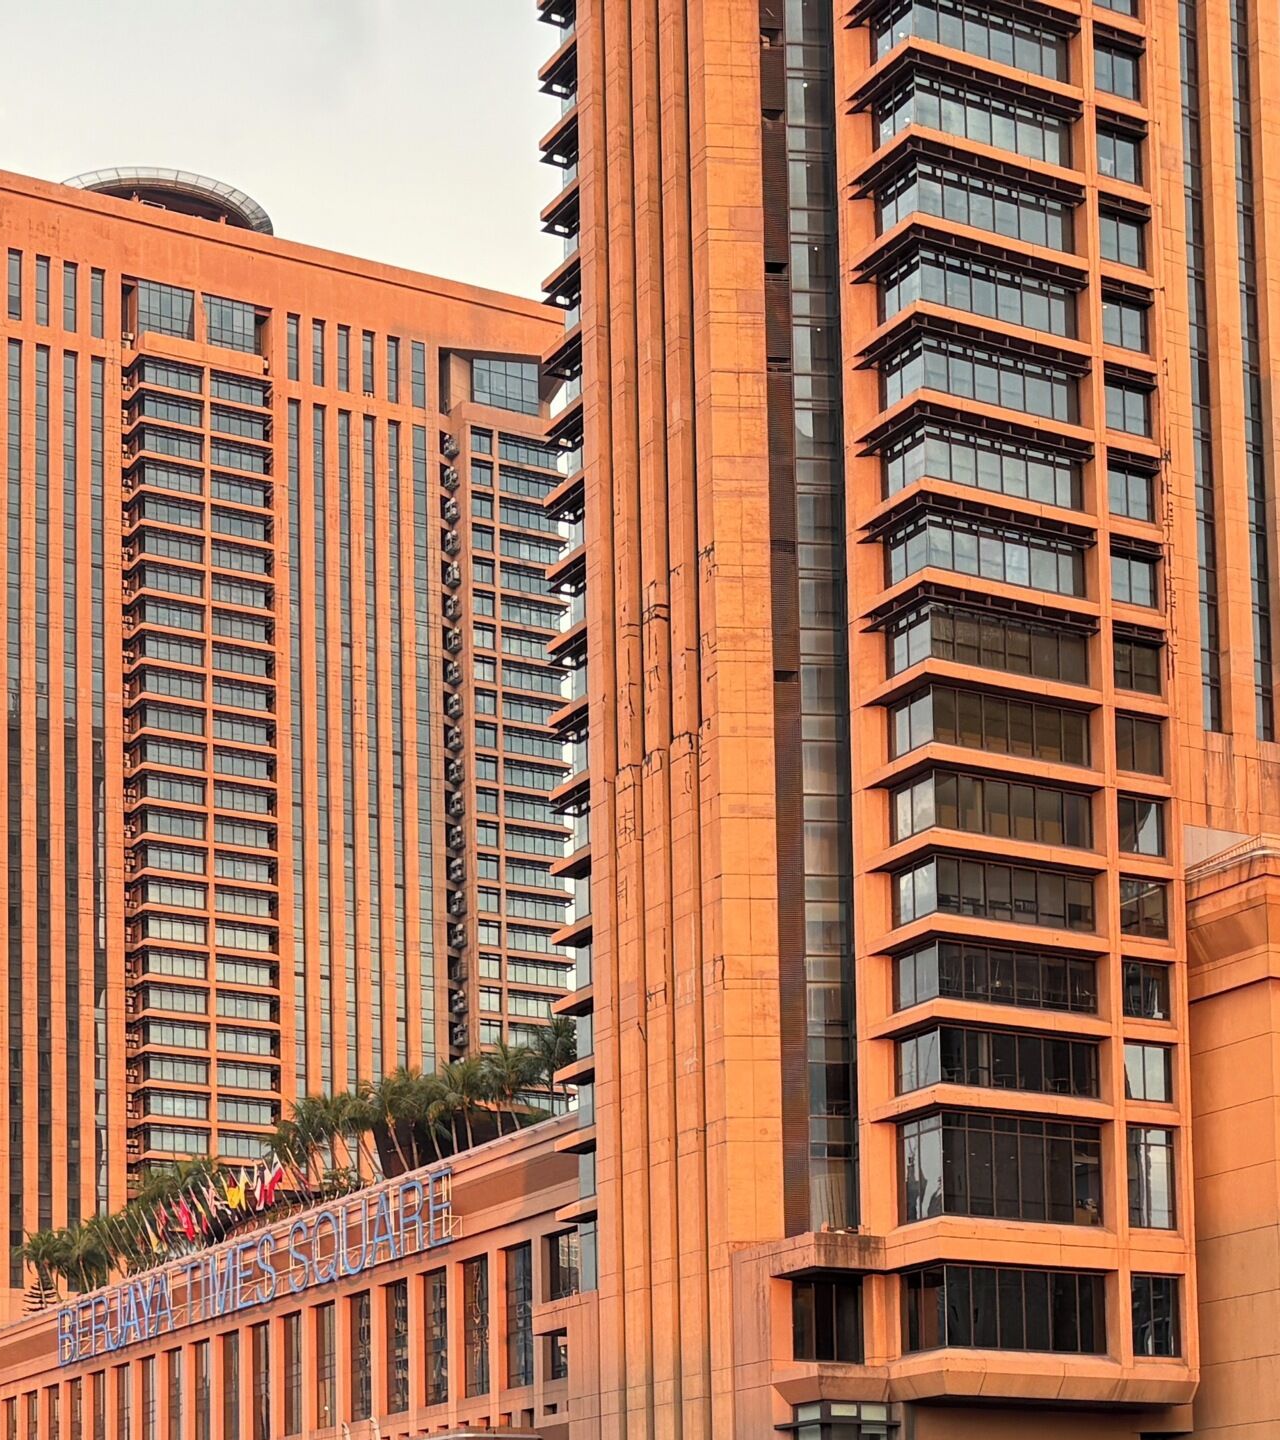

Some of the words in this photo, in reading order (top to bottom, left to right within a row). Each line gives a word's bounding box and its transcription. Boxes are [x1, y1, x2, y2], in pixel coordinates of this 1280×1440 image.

[57, 1270, 175, 1367] BERJAYA
[182, 1232, 276, 1326] TIMES
[288, 1168, 453, 1293] SQUARE
